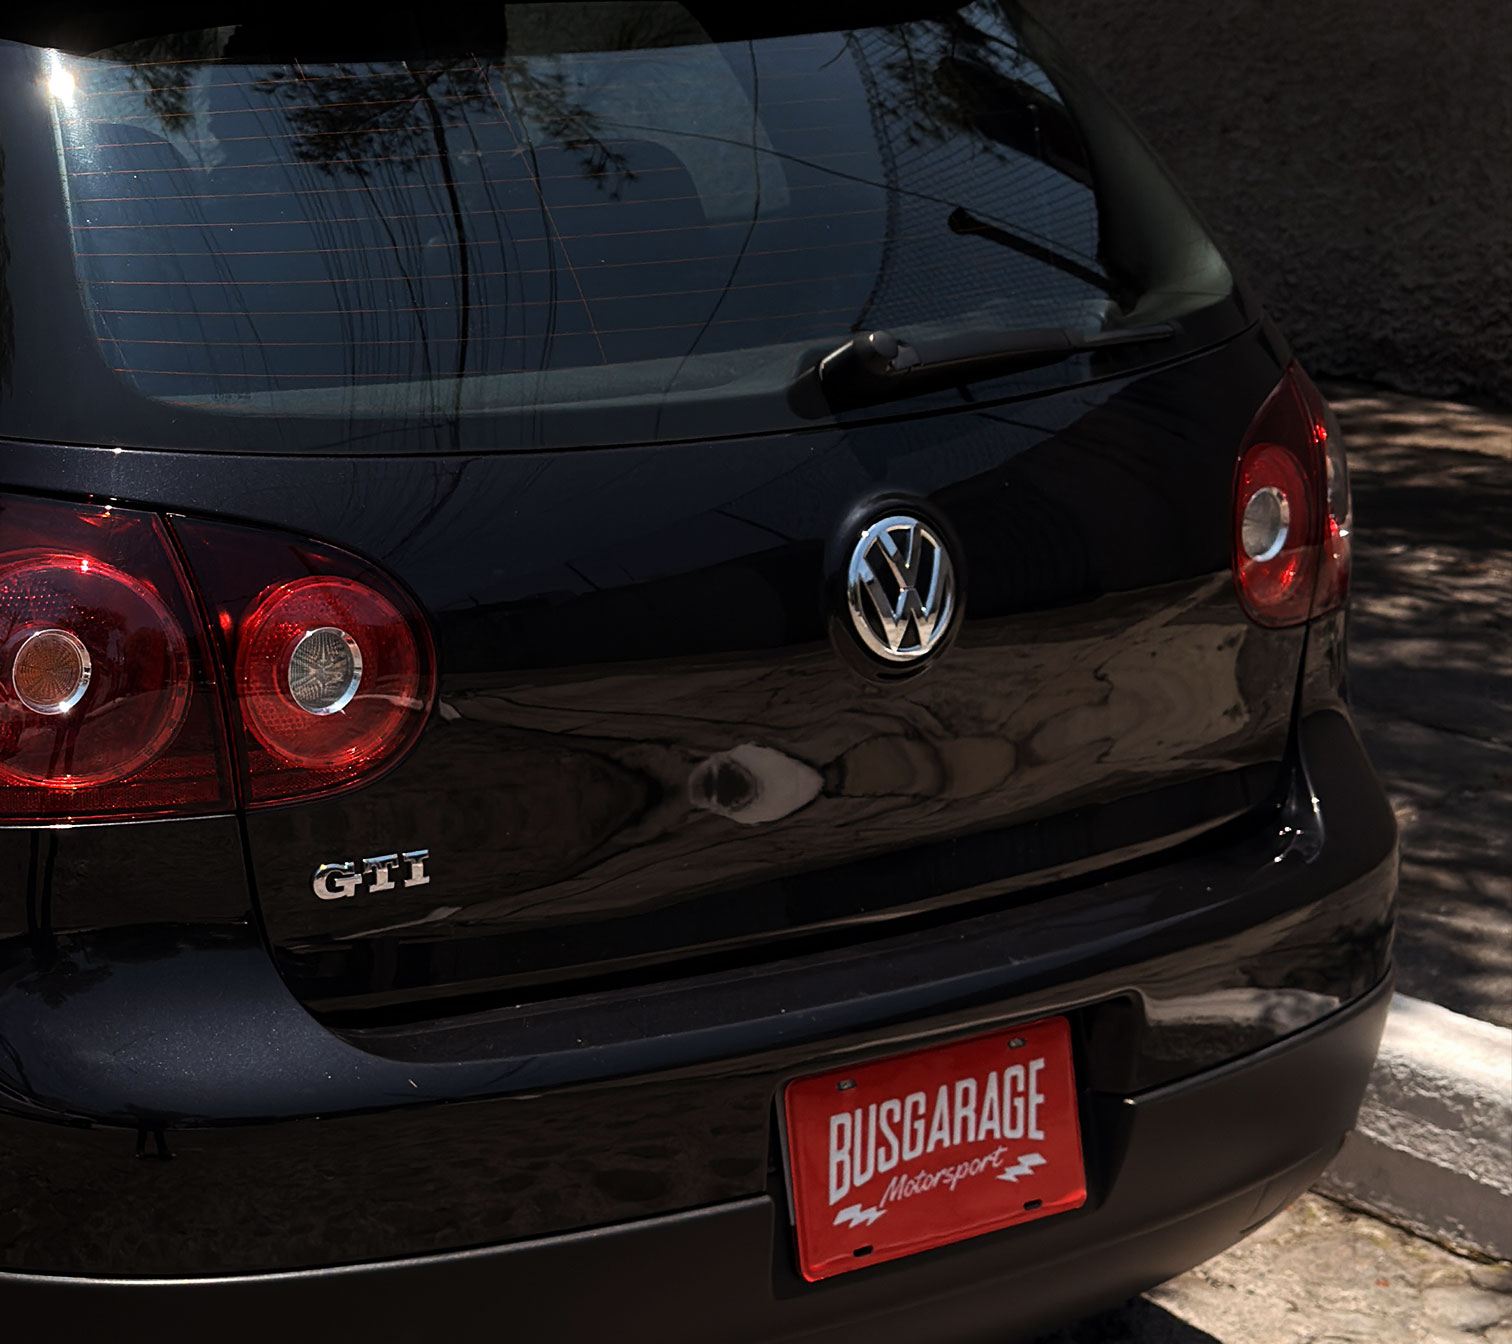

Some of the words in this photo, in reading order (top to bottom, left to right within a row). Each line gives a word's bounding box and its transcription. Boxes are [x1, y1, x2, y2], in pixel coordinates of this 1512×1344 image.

[313, 849, 430, 901] GTI
[829, 1057, 1046, 1206] BUSGARAGE
[879, 1146, 1008, 1208] Motorsport
